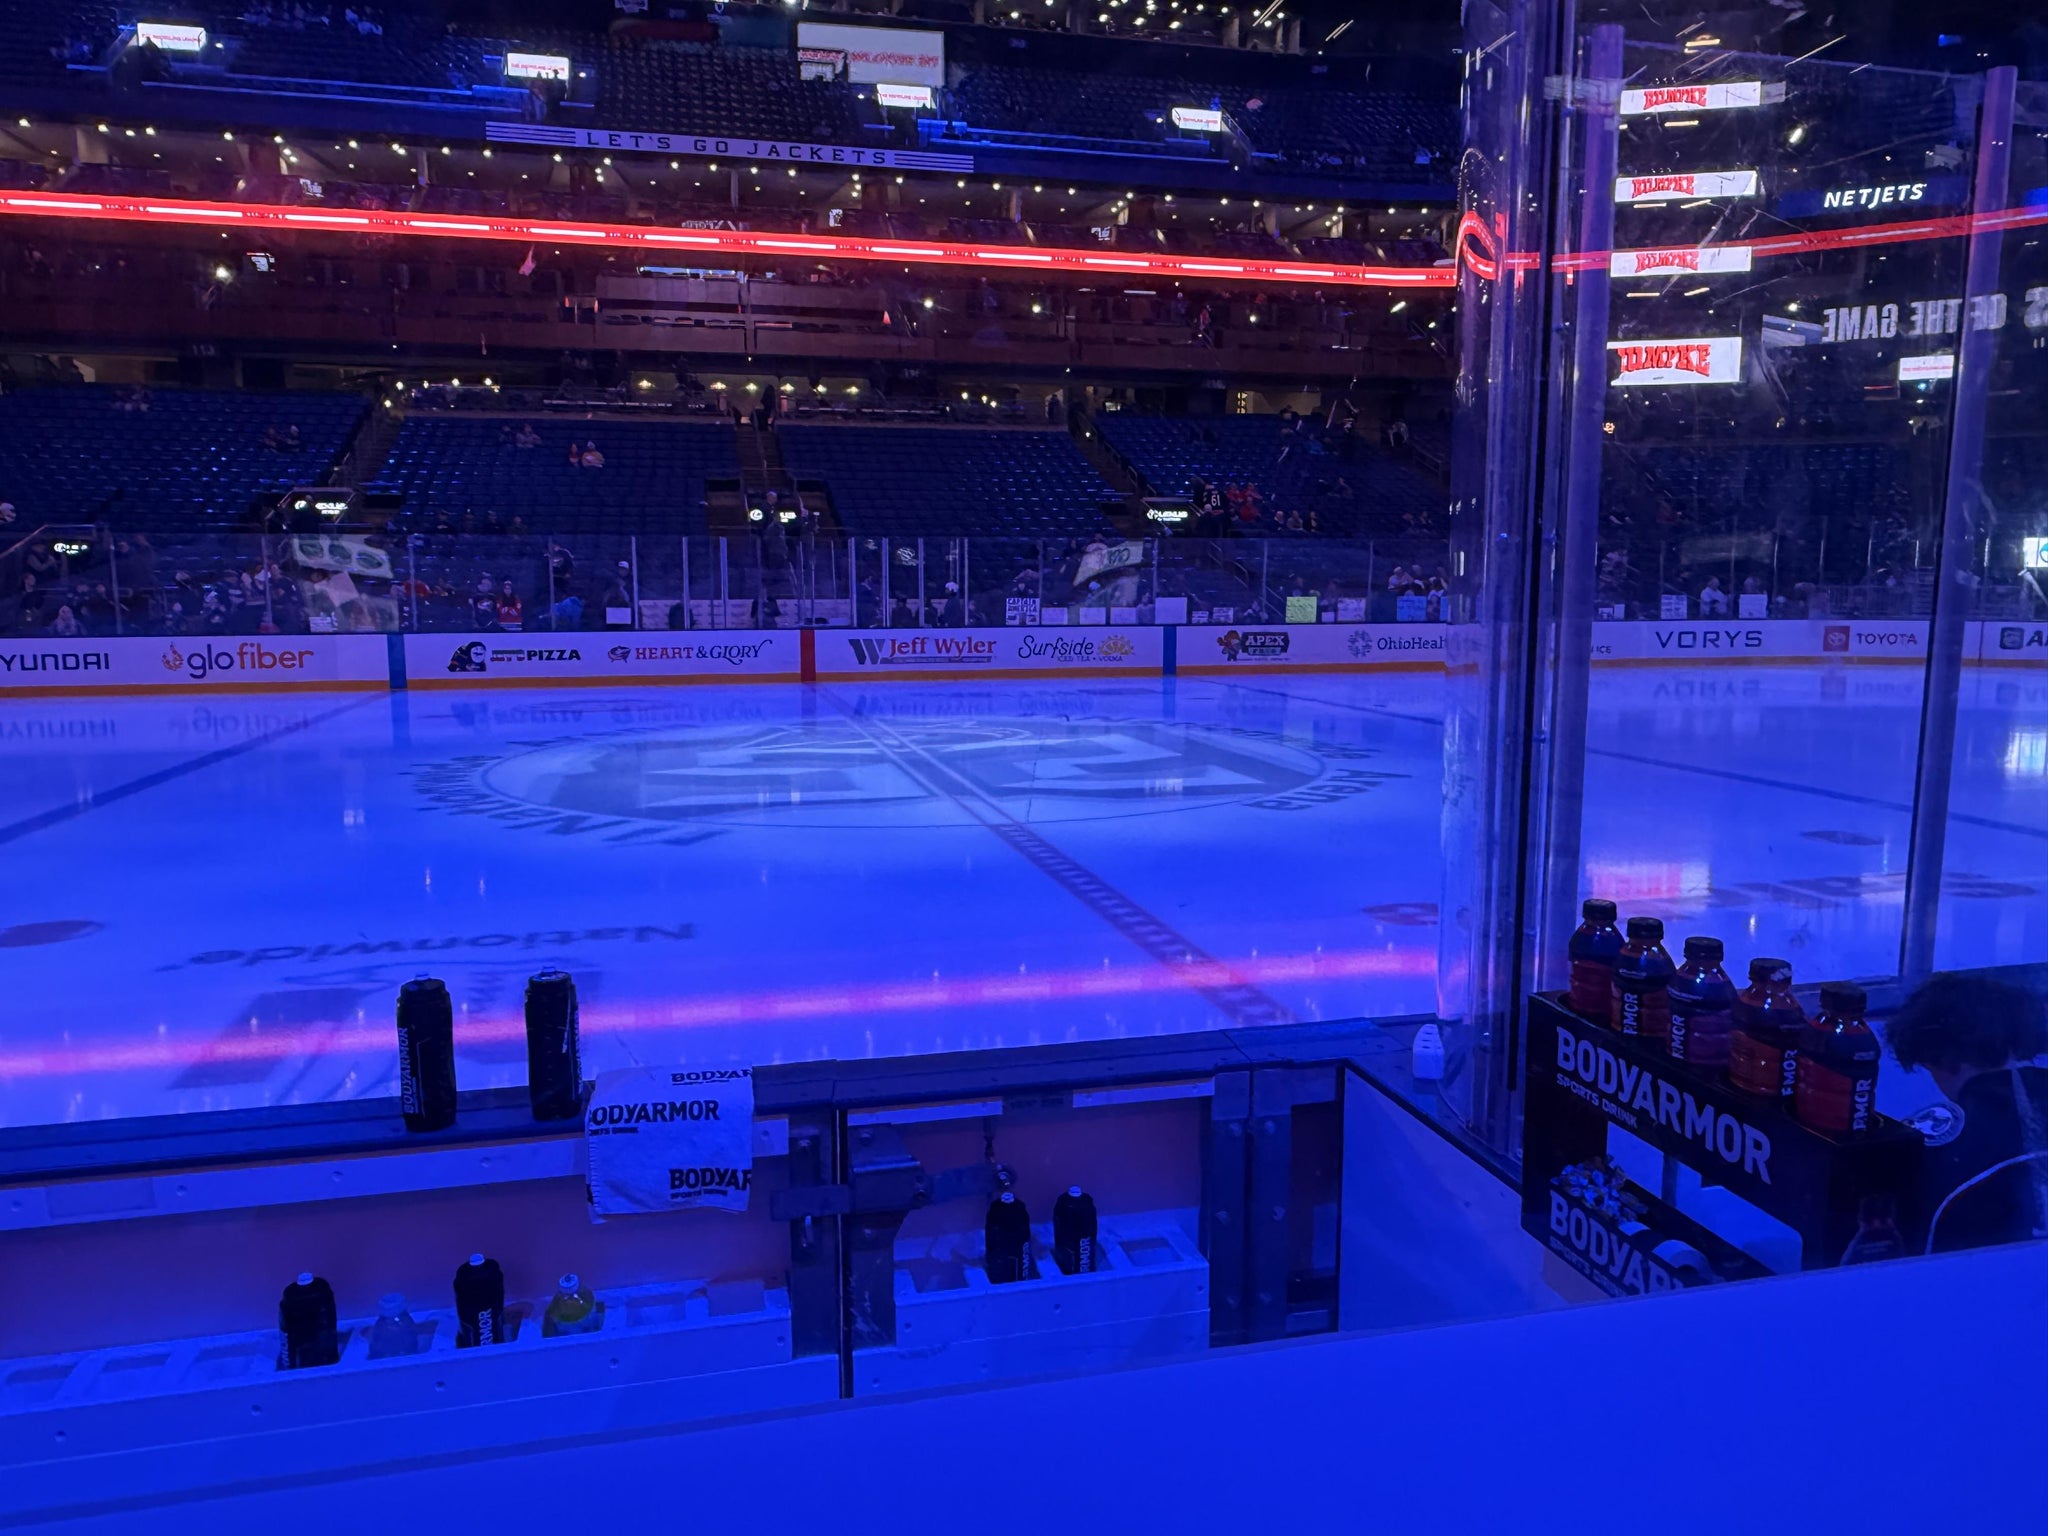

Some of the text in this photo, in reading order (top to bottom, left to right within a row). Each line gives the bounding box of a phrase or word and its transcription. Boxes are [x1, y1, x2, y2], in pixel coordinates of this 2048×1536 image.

[587, 132, 886, 164] LET'S GO JACKETS
[1823, 184, 1926, 209] NETJETS
[1211, 494, 1221, 507] 61
[889, 636, 997, 658] Jeff Wyler
[1018, 635, 1094, 658] Surfside
[1245, 635, 1285, 646] APEX
[1377, 636, 1446, 650] OhioHeal
[1655, 631, 1763, 648] VORYS
[1856, 632, 1918, 646] TOYOTA
[2025, 630, 2048, 647] A
[526, 649, 582, 661] PIZZA
[635, 647, 694, 660] HEART
[1591, 645, 1612, 654] ICE
[1556, 1073, 1638, 1128] SPORTS DRINK
[1556, 1026, 1772, 1185] BODYARMOR
[590, 1100, 720, 1126] ODYARMOR
